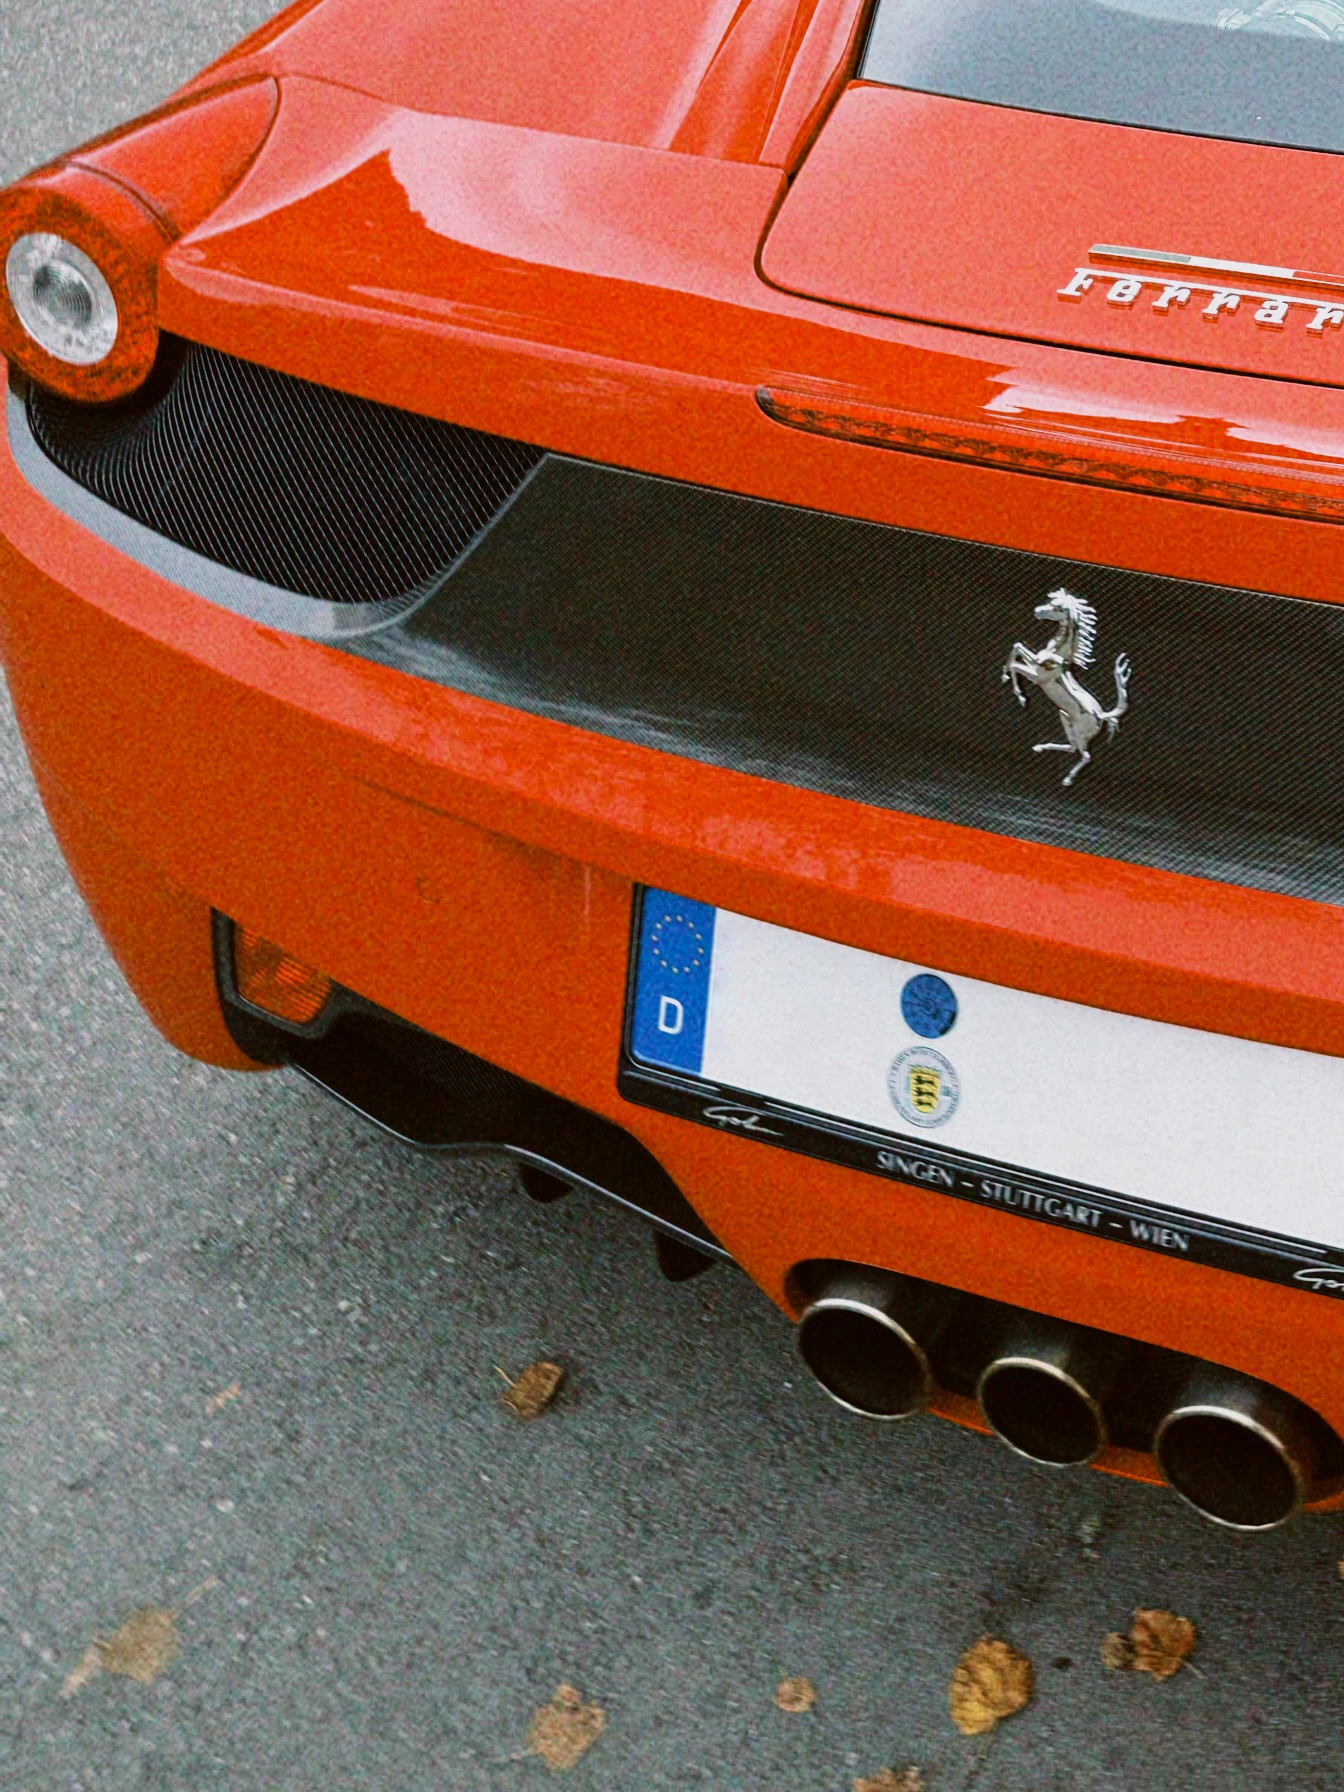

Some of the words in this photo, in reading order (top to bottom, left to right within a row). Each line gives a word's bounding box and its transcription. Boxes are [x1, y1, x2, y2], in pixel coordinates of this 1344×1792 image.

[657, 995, 685, 1035] D
[876, 1150, 955, 1188] SINGEN
[979, 1179, 1104, 1228] STUTTGART
[1129, 1218, 1190, 1252] WIEN
